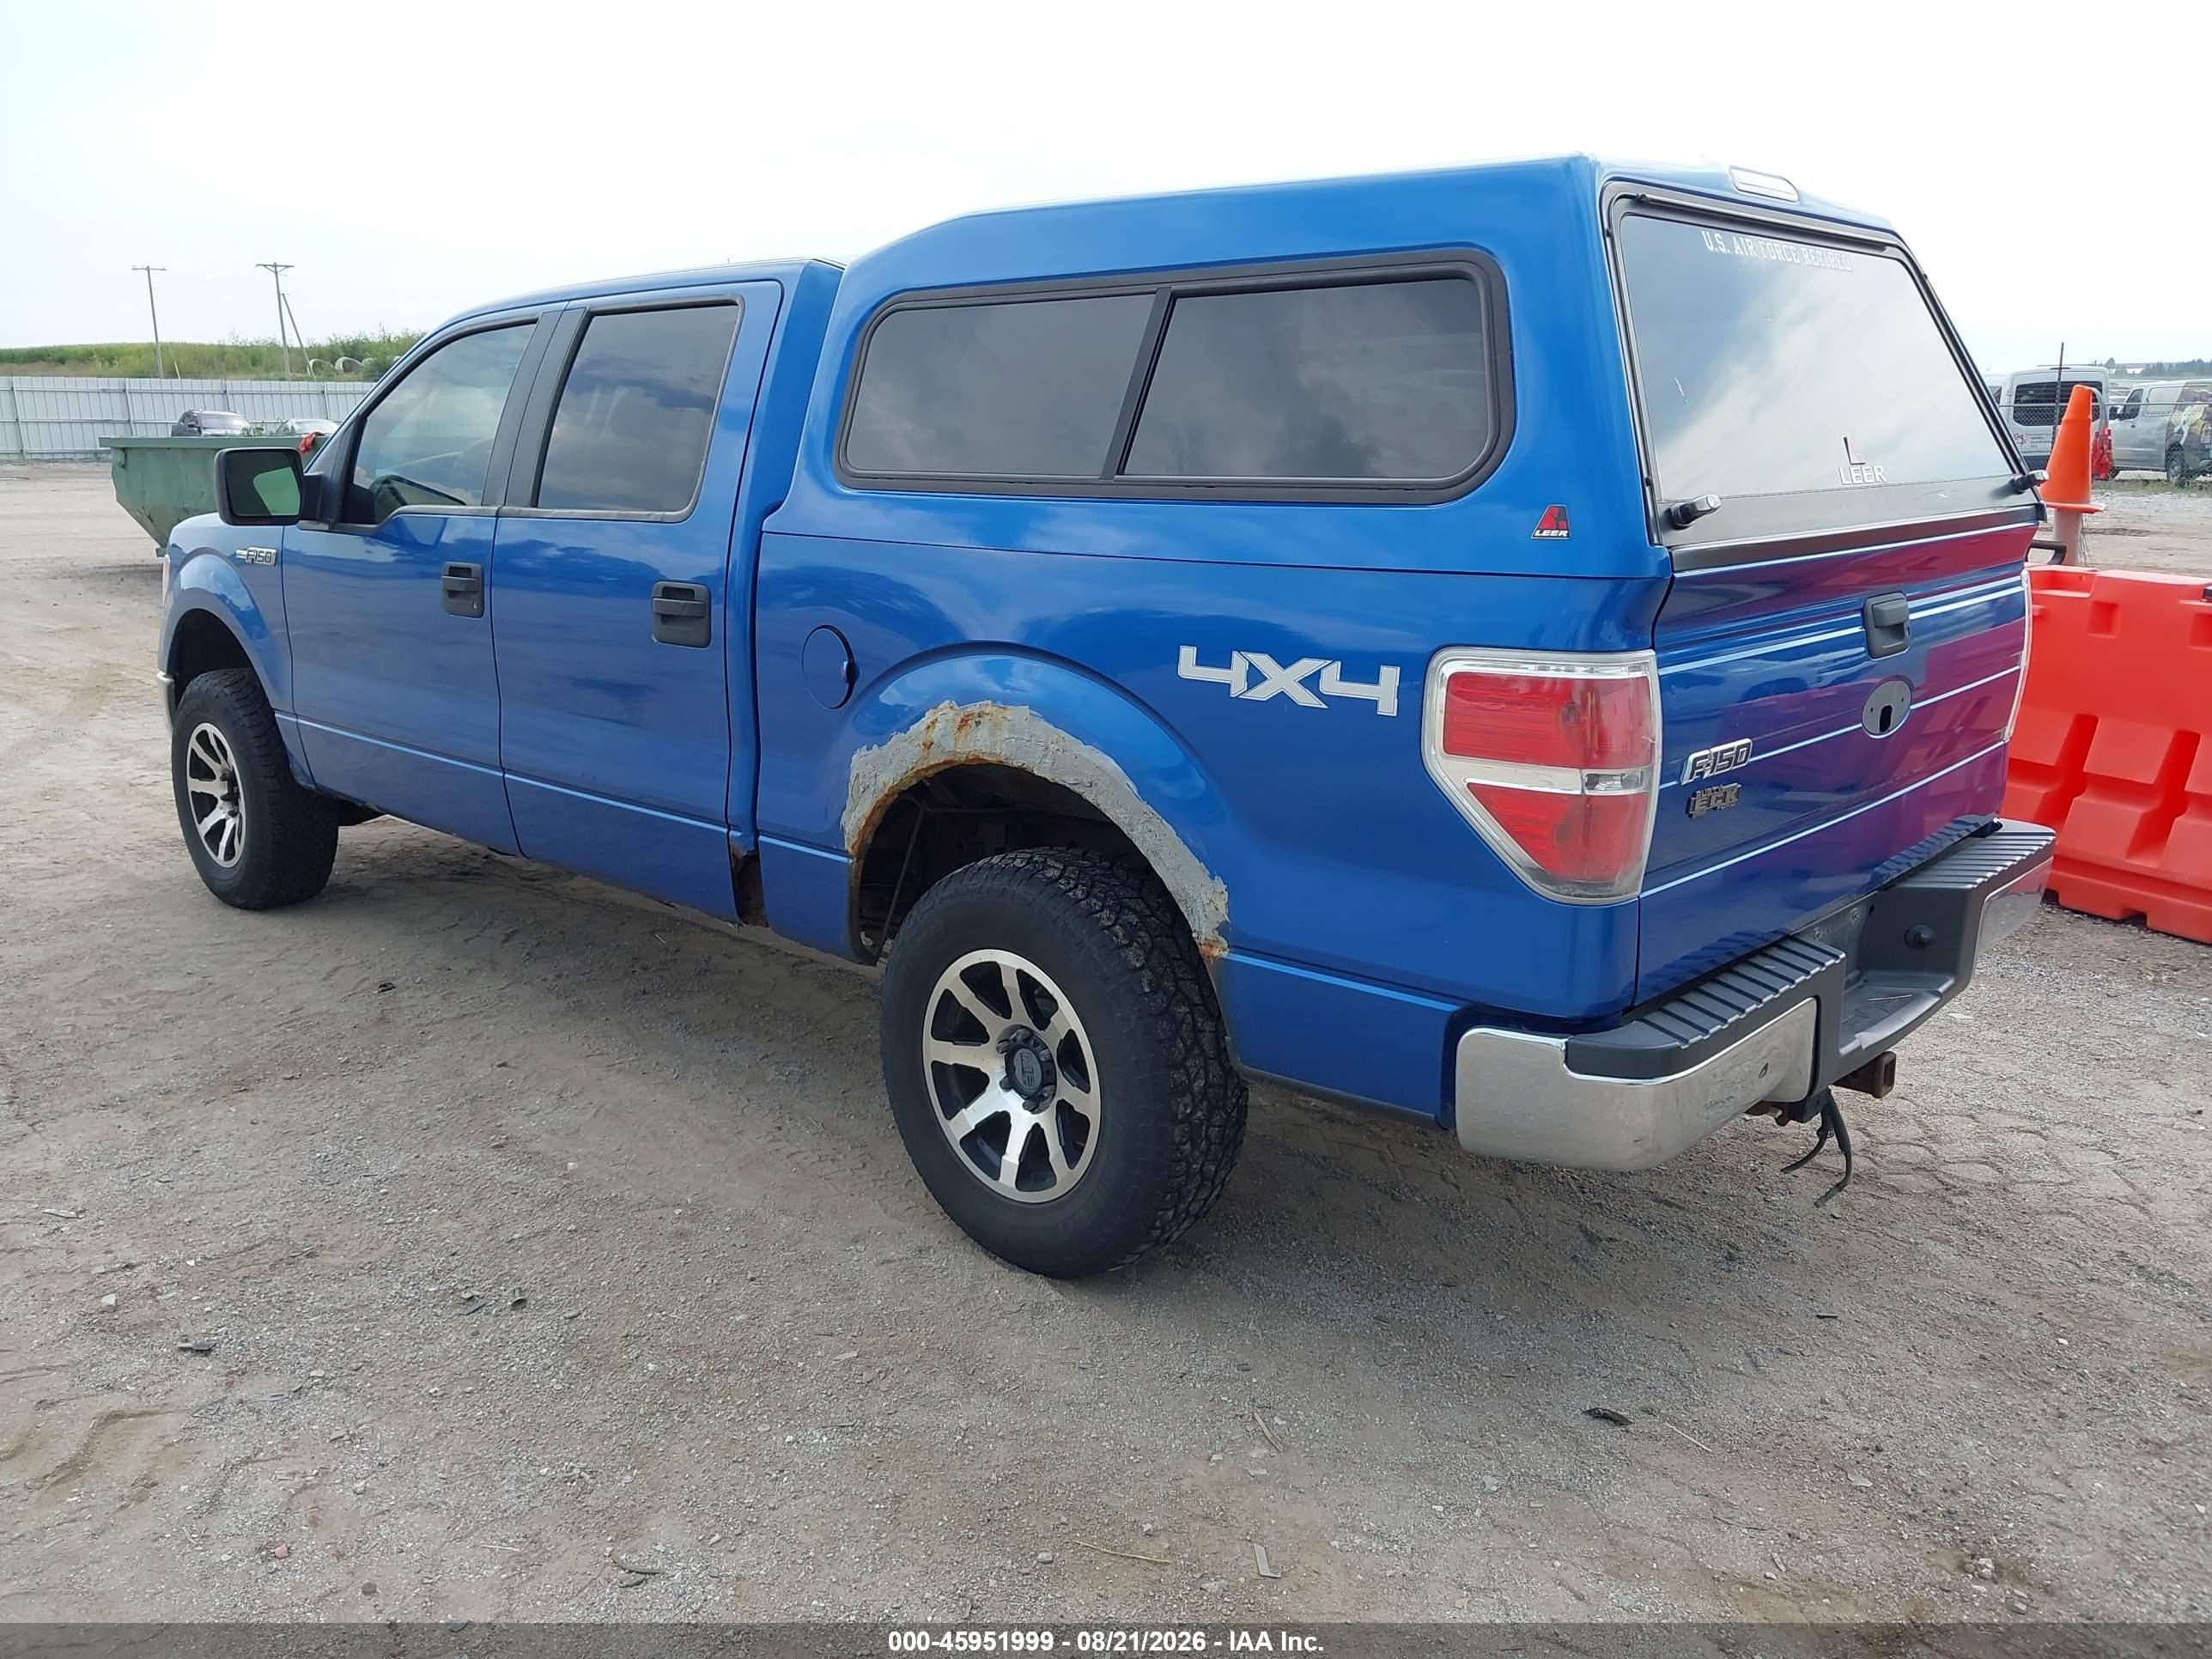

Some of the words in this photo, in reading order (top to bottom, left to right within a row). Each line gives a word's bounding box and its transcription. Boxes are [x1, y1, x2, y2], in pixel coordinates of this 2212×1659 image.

[1701, 230, 1730, 254] U.S.
[1732, 236, 1758, 258] AIR
[1758, 240, 1801, 264] FORCE
[1800, 246, 1852, 271] RETIRED
[1838, 466, 1887, 485] LEER
[1681, 738, 1753, 785] F-150
